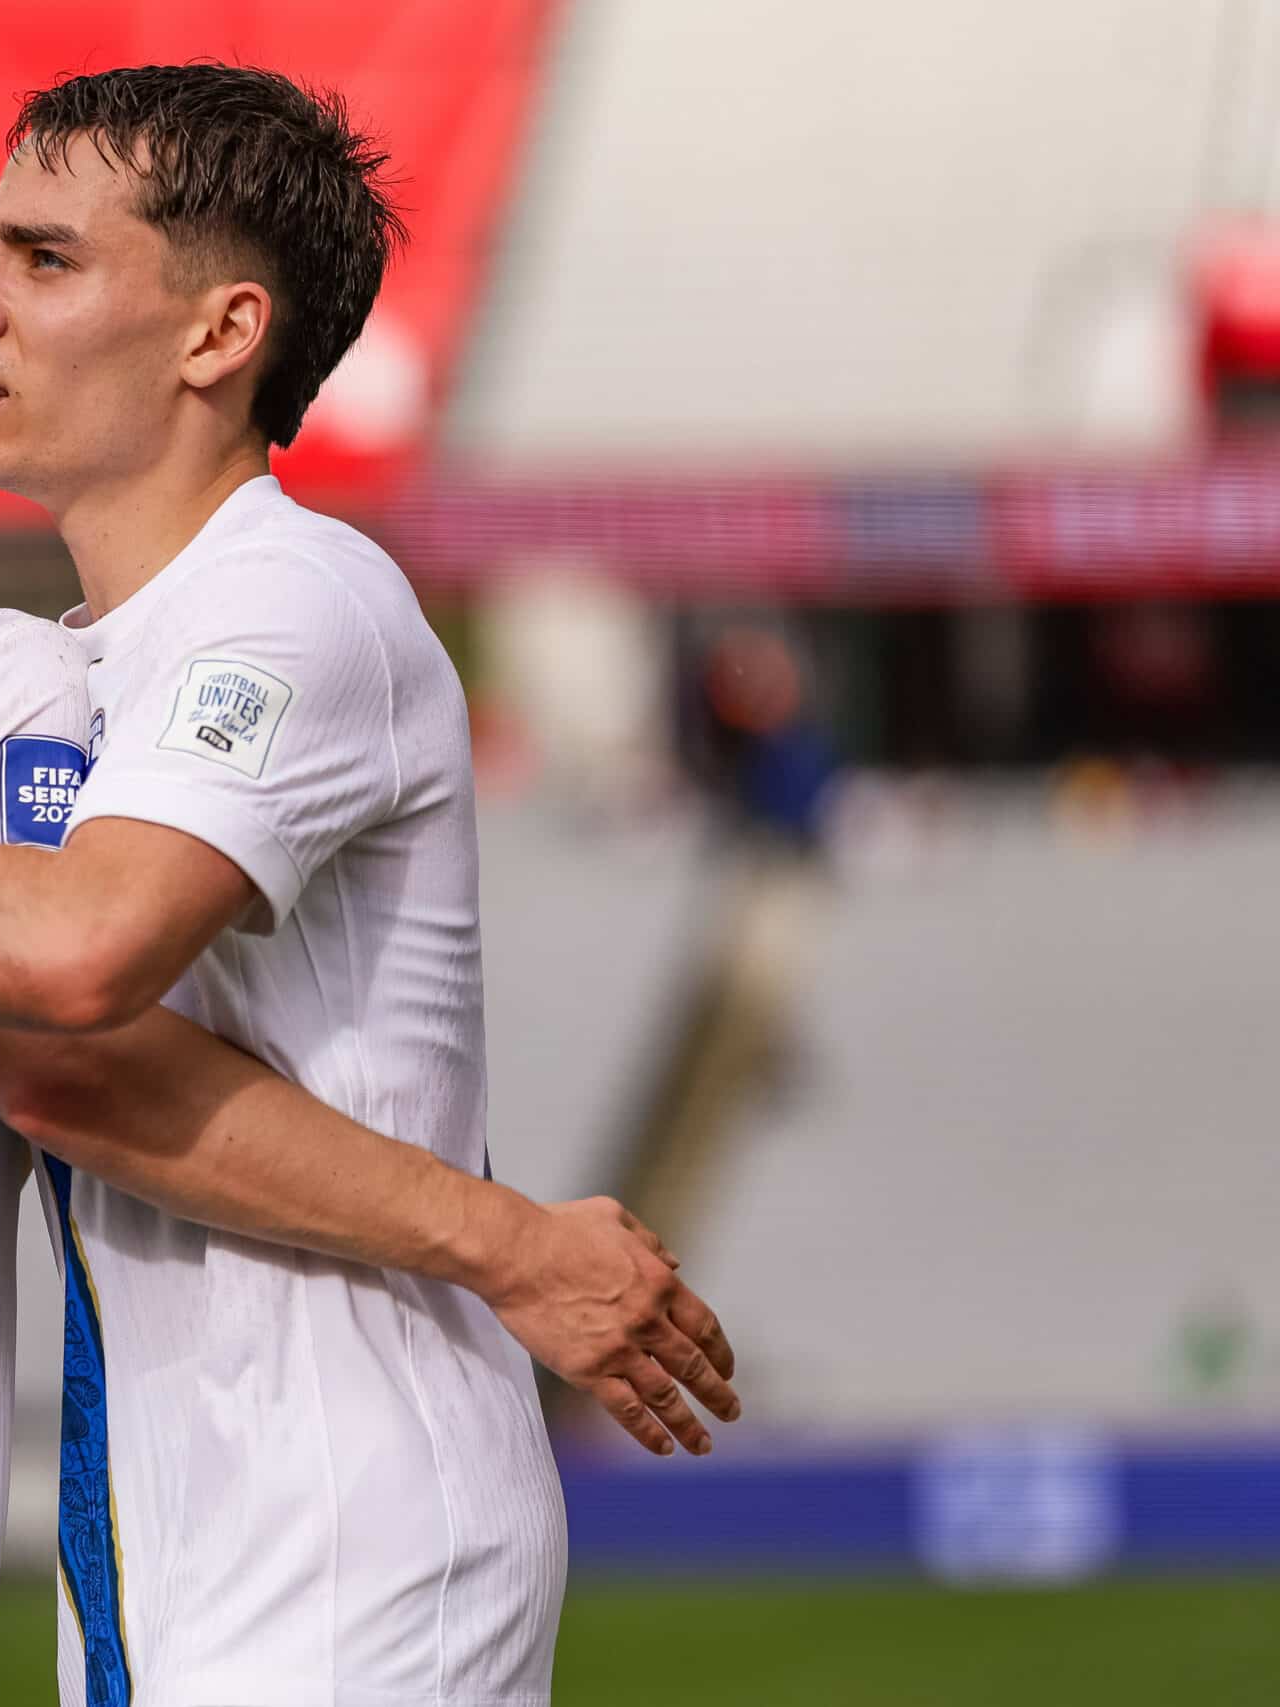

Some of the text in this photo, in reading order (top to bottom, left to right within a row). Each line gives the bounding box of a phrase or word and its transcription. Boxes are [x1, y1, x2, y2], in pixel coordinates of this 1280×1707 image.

[198, 685, 264, 726] UNITES
[32, 766, 82, 787] FIFA
[17, 785, 76, 805] SERI
[31, 804, 73, 824] 202
